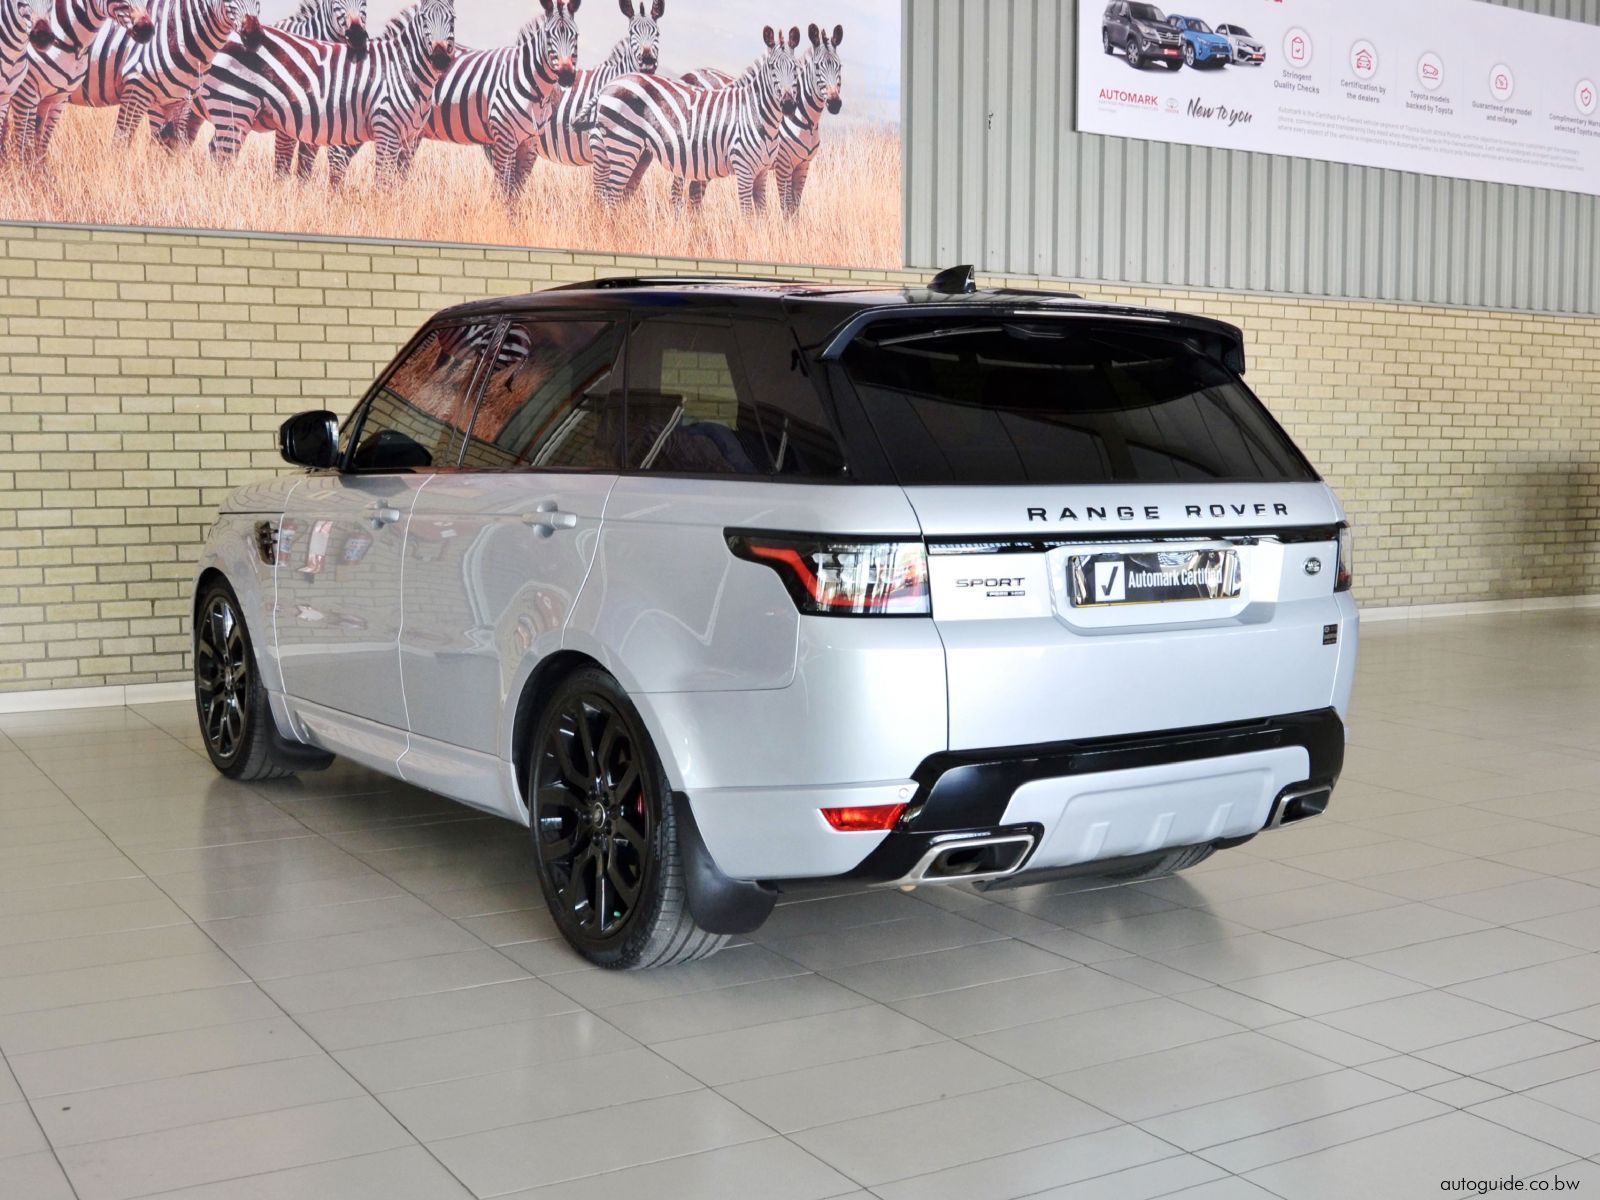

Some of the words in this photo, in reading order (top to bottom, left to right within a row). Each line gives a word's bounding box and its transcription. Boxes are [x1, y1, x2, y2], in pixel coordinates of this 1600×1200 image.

[1282, 69, 1312, 81] Stringent
[1273, 79, 1296, 92] Quality
[1297, 83, 1320, 94] Checks
[1340, 79, 1378, 91] Certification
[1379, 86, 1386, 95] by
[1099, 88, 1159, 106] AUTOMARK
[1358, 94, 1380, 103] dealers
[1410, 90, 1429, 101] Toyota
[1430, 95, 1450, 104] models
[1187, 97, 1214, 119] New
[1227, 109, 1253, 128] you
[1405, 101, 1427, 111] backed
[1427, 105, 1434, 114] by
[1434, 105, 1454, 115] Toyota
[1471, 100, 1503, 112] Guaranteed
[1516, 108, 1533, 116] model
[1576, 126, 1593, 137] Toyota
[1026, 505, 1160, 522] RANGE
[1185, 502, 1289, 519] ROVER
[955, 577, 1026, 588] SPORT
[1128, 570, 1180, 590] Automark
